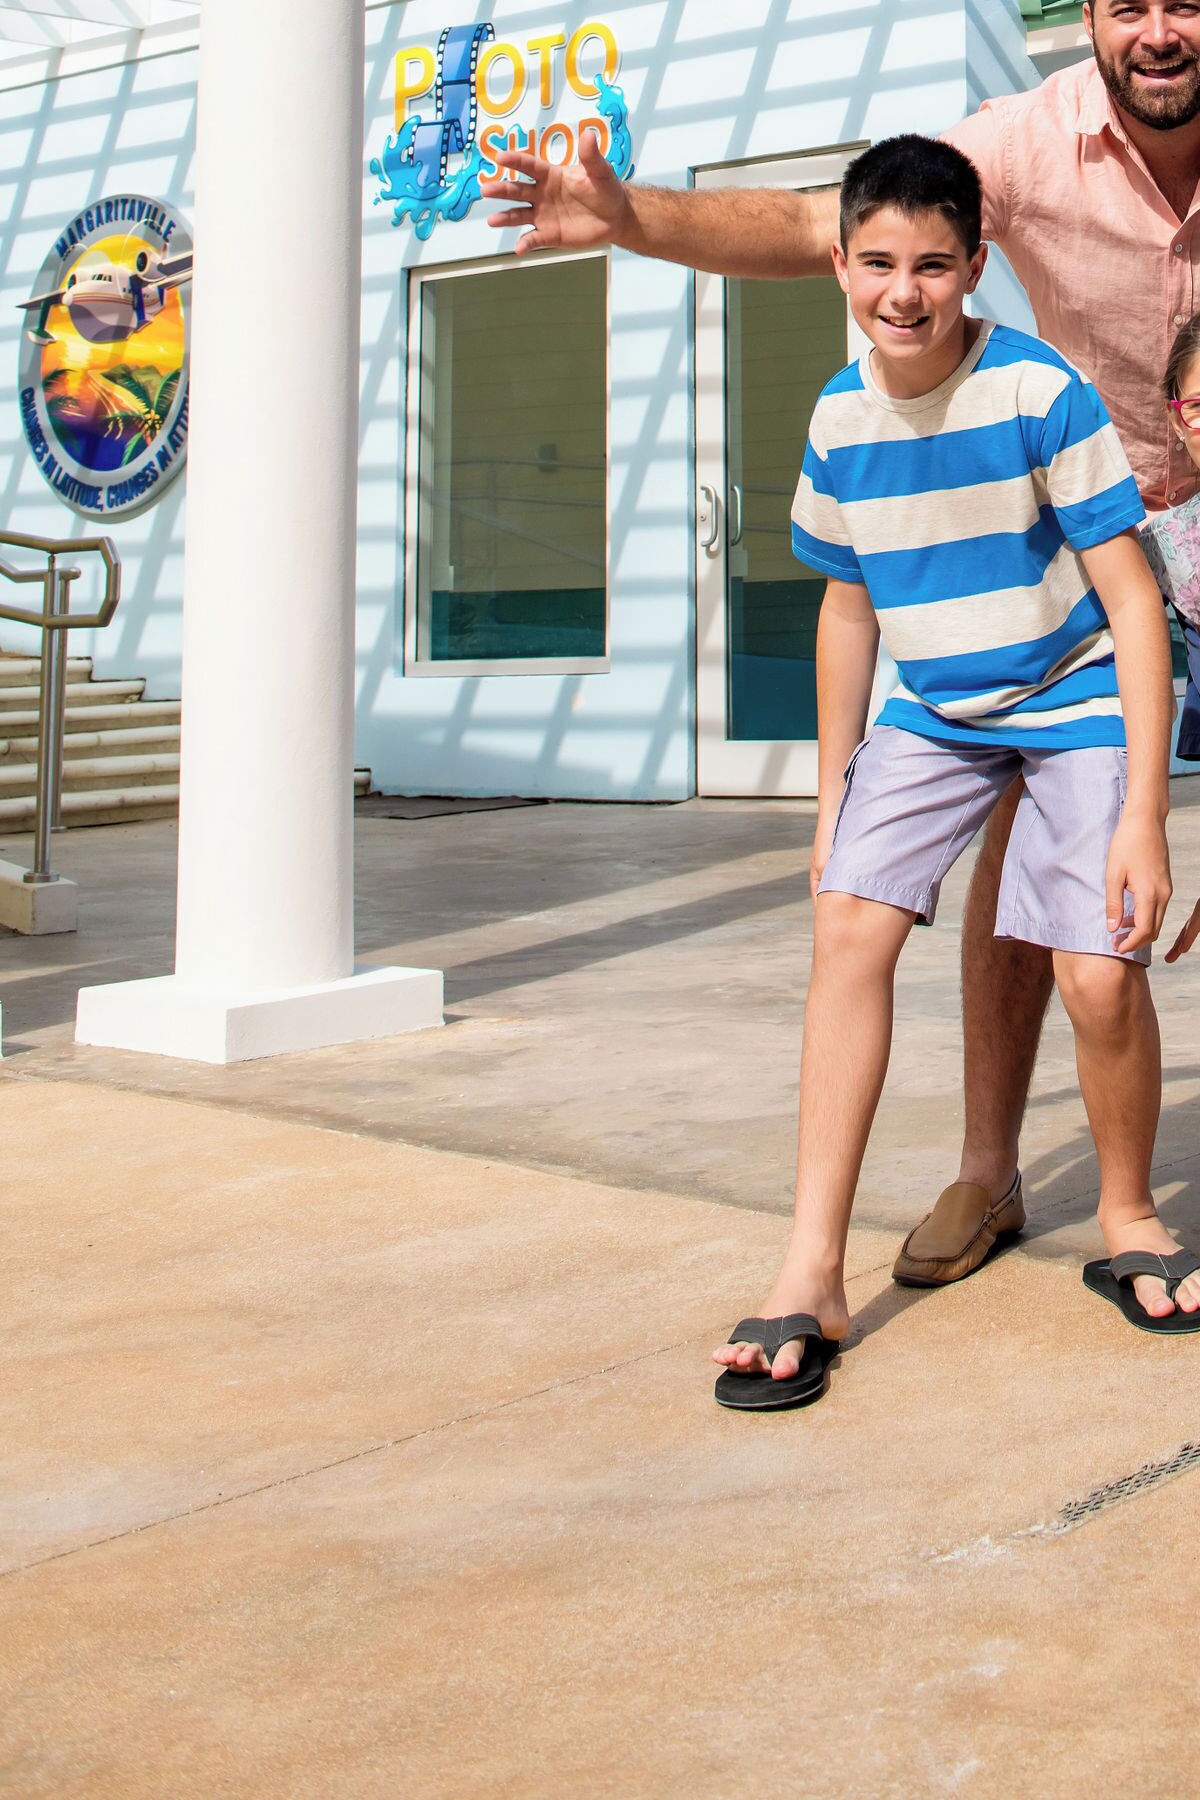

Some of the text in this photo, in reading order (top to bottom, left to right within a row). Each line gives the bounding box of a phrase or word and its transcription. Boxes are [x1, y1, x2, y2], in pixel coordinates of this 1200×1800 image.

[394, 22, 619, 145] PHOTO
[55, 198, 176, 258] MARGARITAVILLE
[21, 386, 49, 462] CHANGES
[42, 454, 58, 479] IN
[52, 466, 105, 512] LATITUDE,
[106, 461, 159, 509] CHANGES
[155, 444, 173, 472] IN
